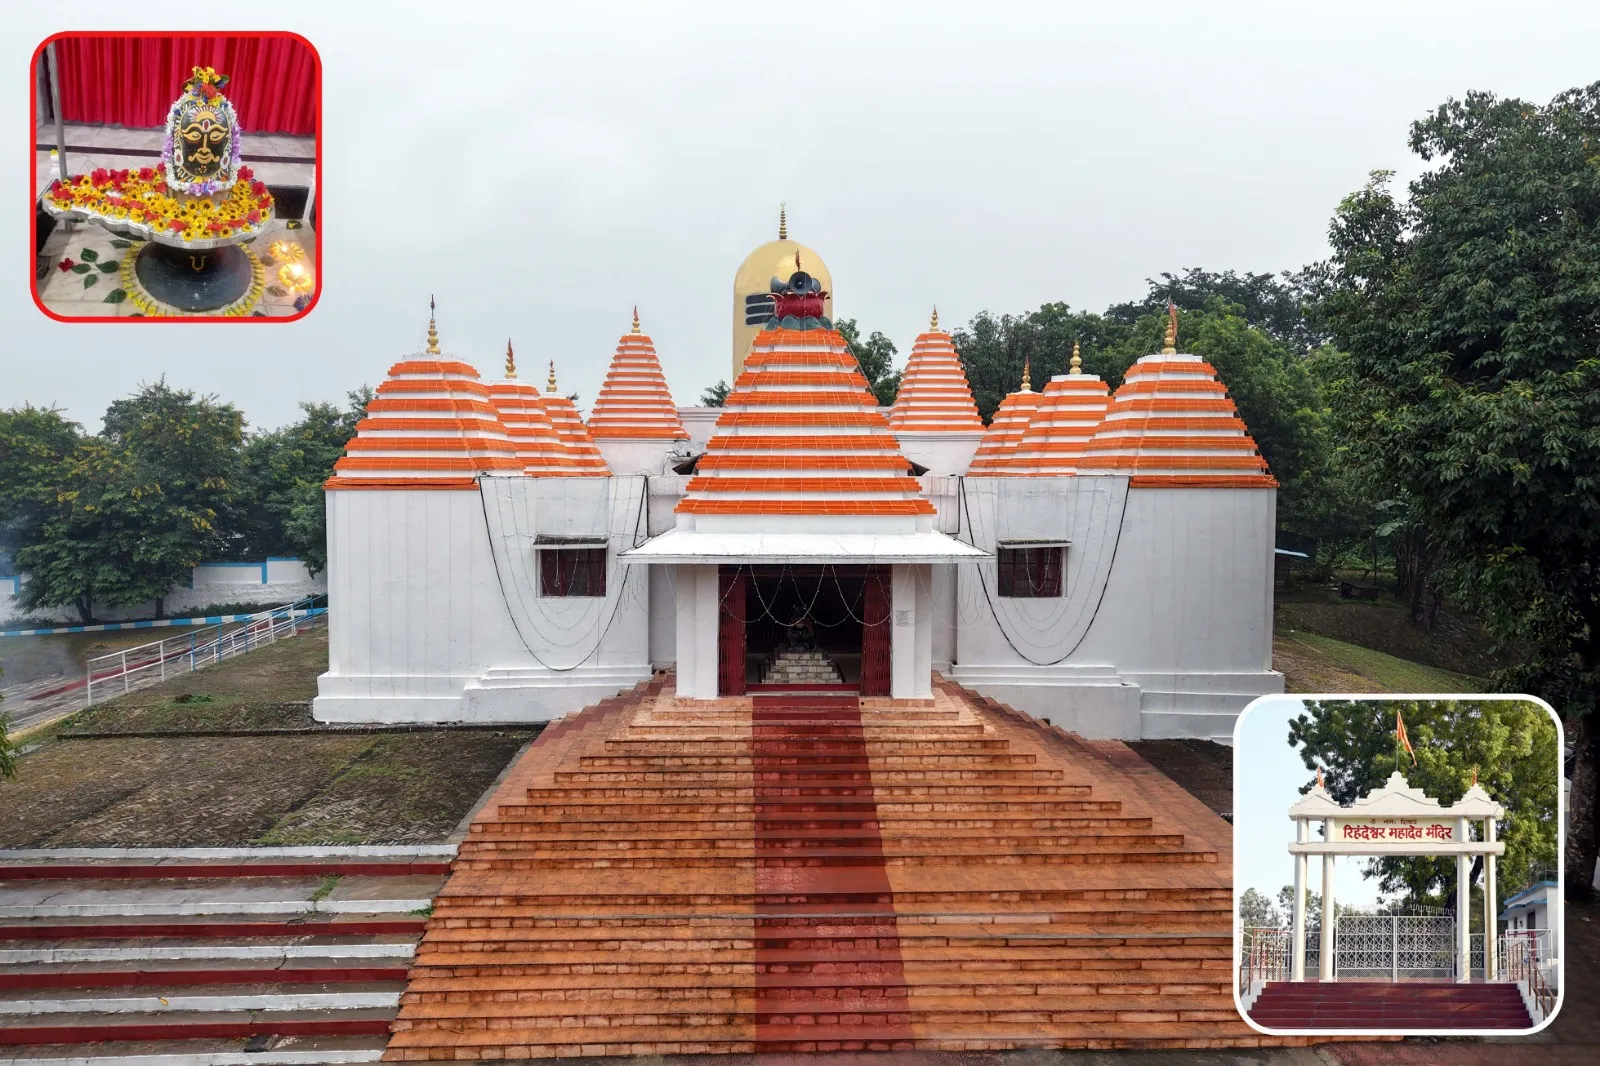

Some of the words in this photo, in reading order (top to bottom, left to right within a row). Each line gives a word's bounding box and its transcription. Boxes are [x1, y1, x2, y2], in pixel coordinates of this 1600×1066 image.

[1343, 824, 1385, 840] रिहंदेश्वर
[1389, 825, 1423, 839] महादेव
[1426, 824, 1452, 840] मंदिर
